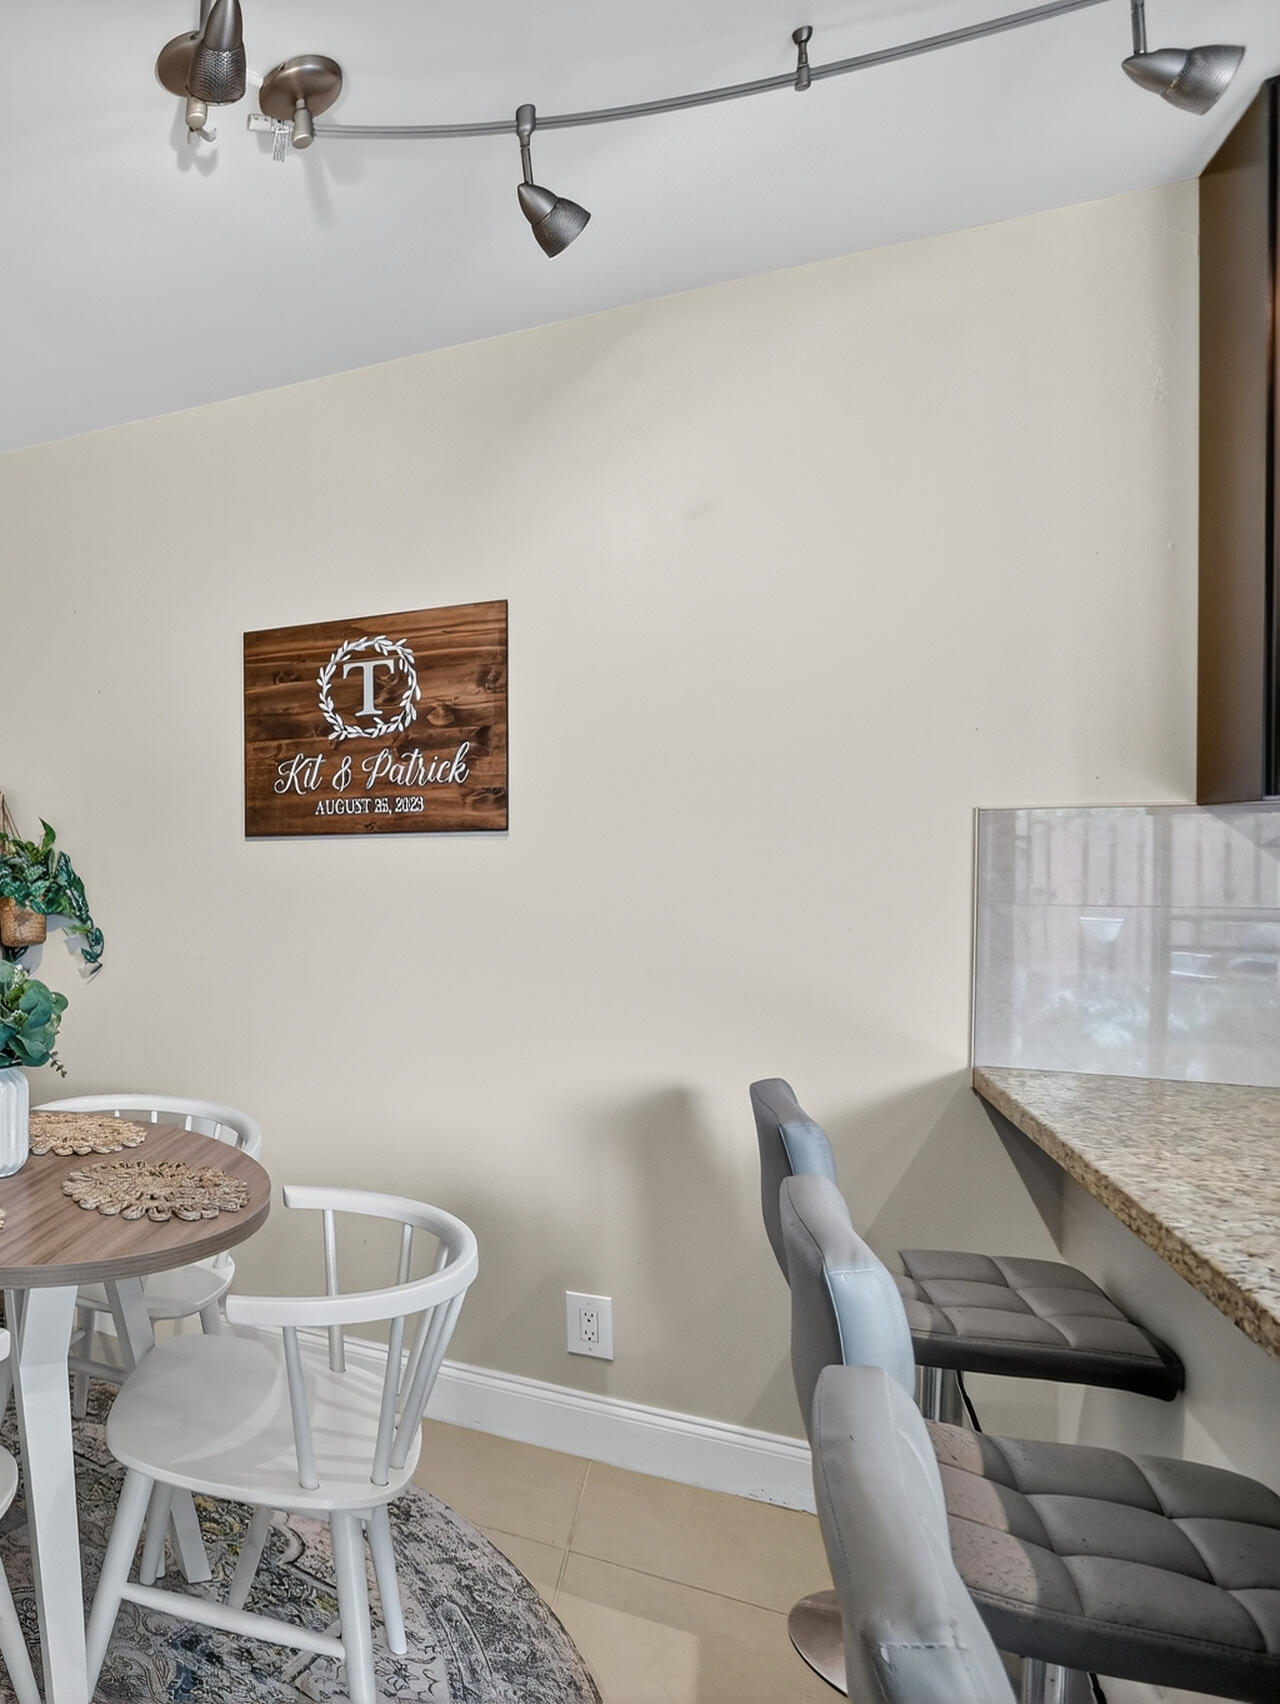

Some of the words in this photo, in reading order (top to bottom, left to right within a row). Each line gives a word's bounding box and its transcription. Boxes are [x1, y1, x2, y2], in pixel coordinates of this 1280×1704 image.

[343, 659, 395, 717] T
[274, 753, 326, 795] Kit
[332, 755, 352, 792] &
[361, 741, 470, 790] Patrick
[315, 798, 371, 815] AUGUST
